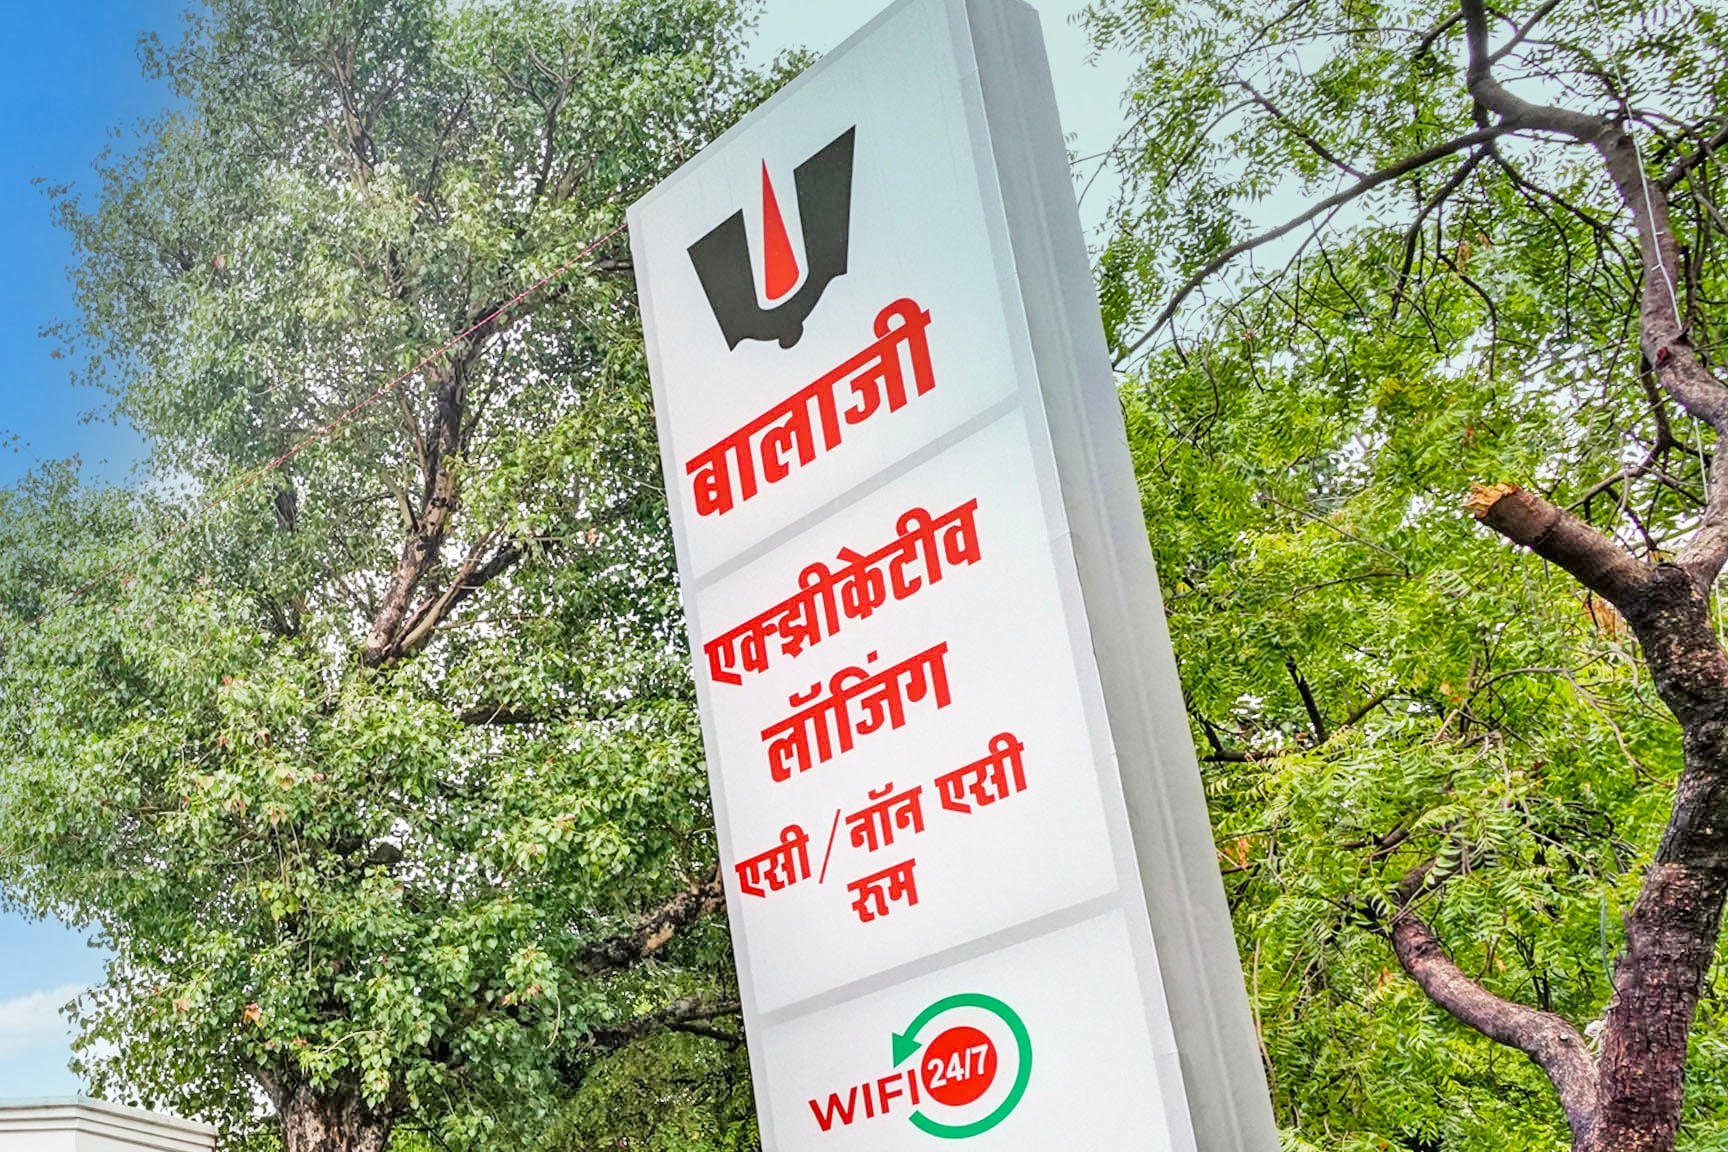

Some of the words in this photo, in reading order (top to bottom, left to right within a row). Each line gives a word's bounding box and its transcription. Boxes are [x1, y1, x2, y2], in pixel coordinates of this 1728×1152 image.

[685, 298, 936, 517] बालाजी
[704, 497, 982, 686] एक्झीकेटीव
[760, 640, 953, 783] लॉजिंग
[734, 824, 812, 898] एसी
[818, 809, 841, 884] /
[845, 782, 925, 852] नॉन
[934, 731, 1028, 814] एसी
[847, 858, 919, 923] रूम
[808, 1069, 921, 1132] WIFI
[926, 1043, 990, 1089] 24/7
